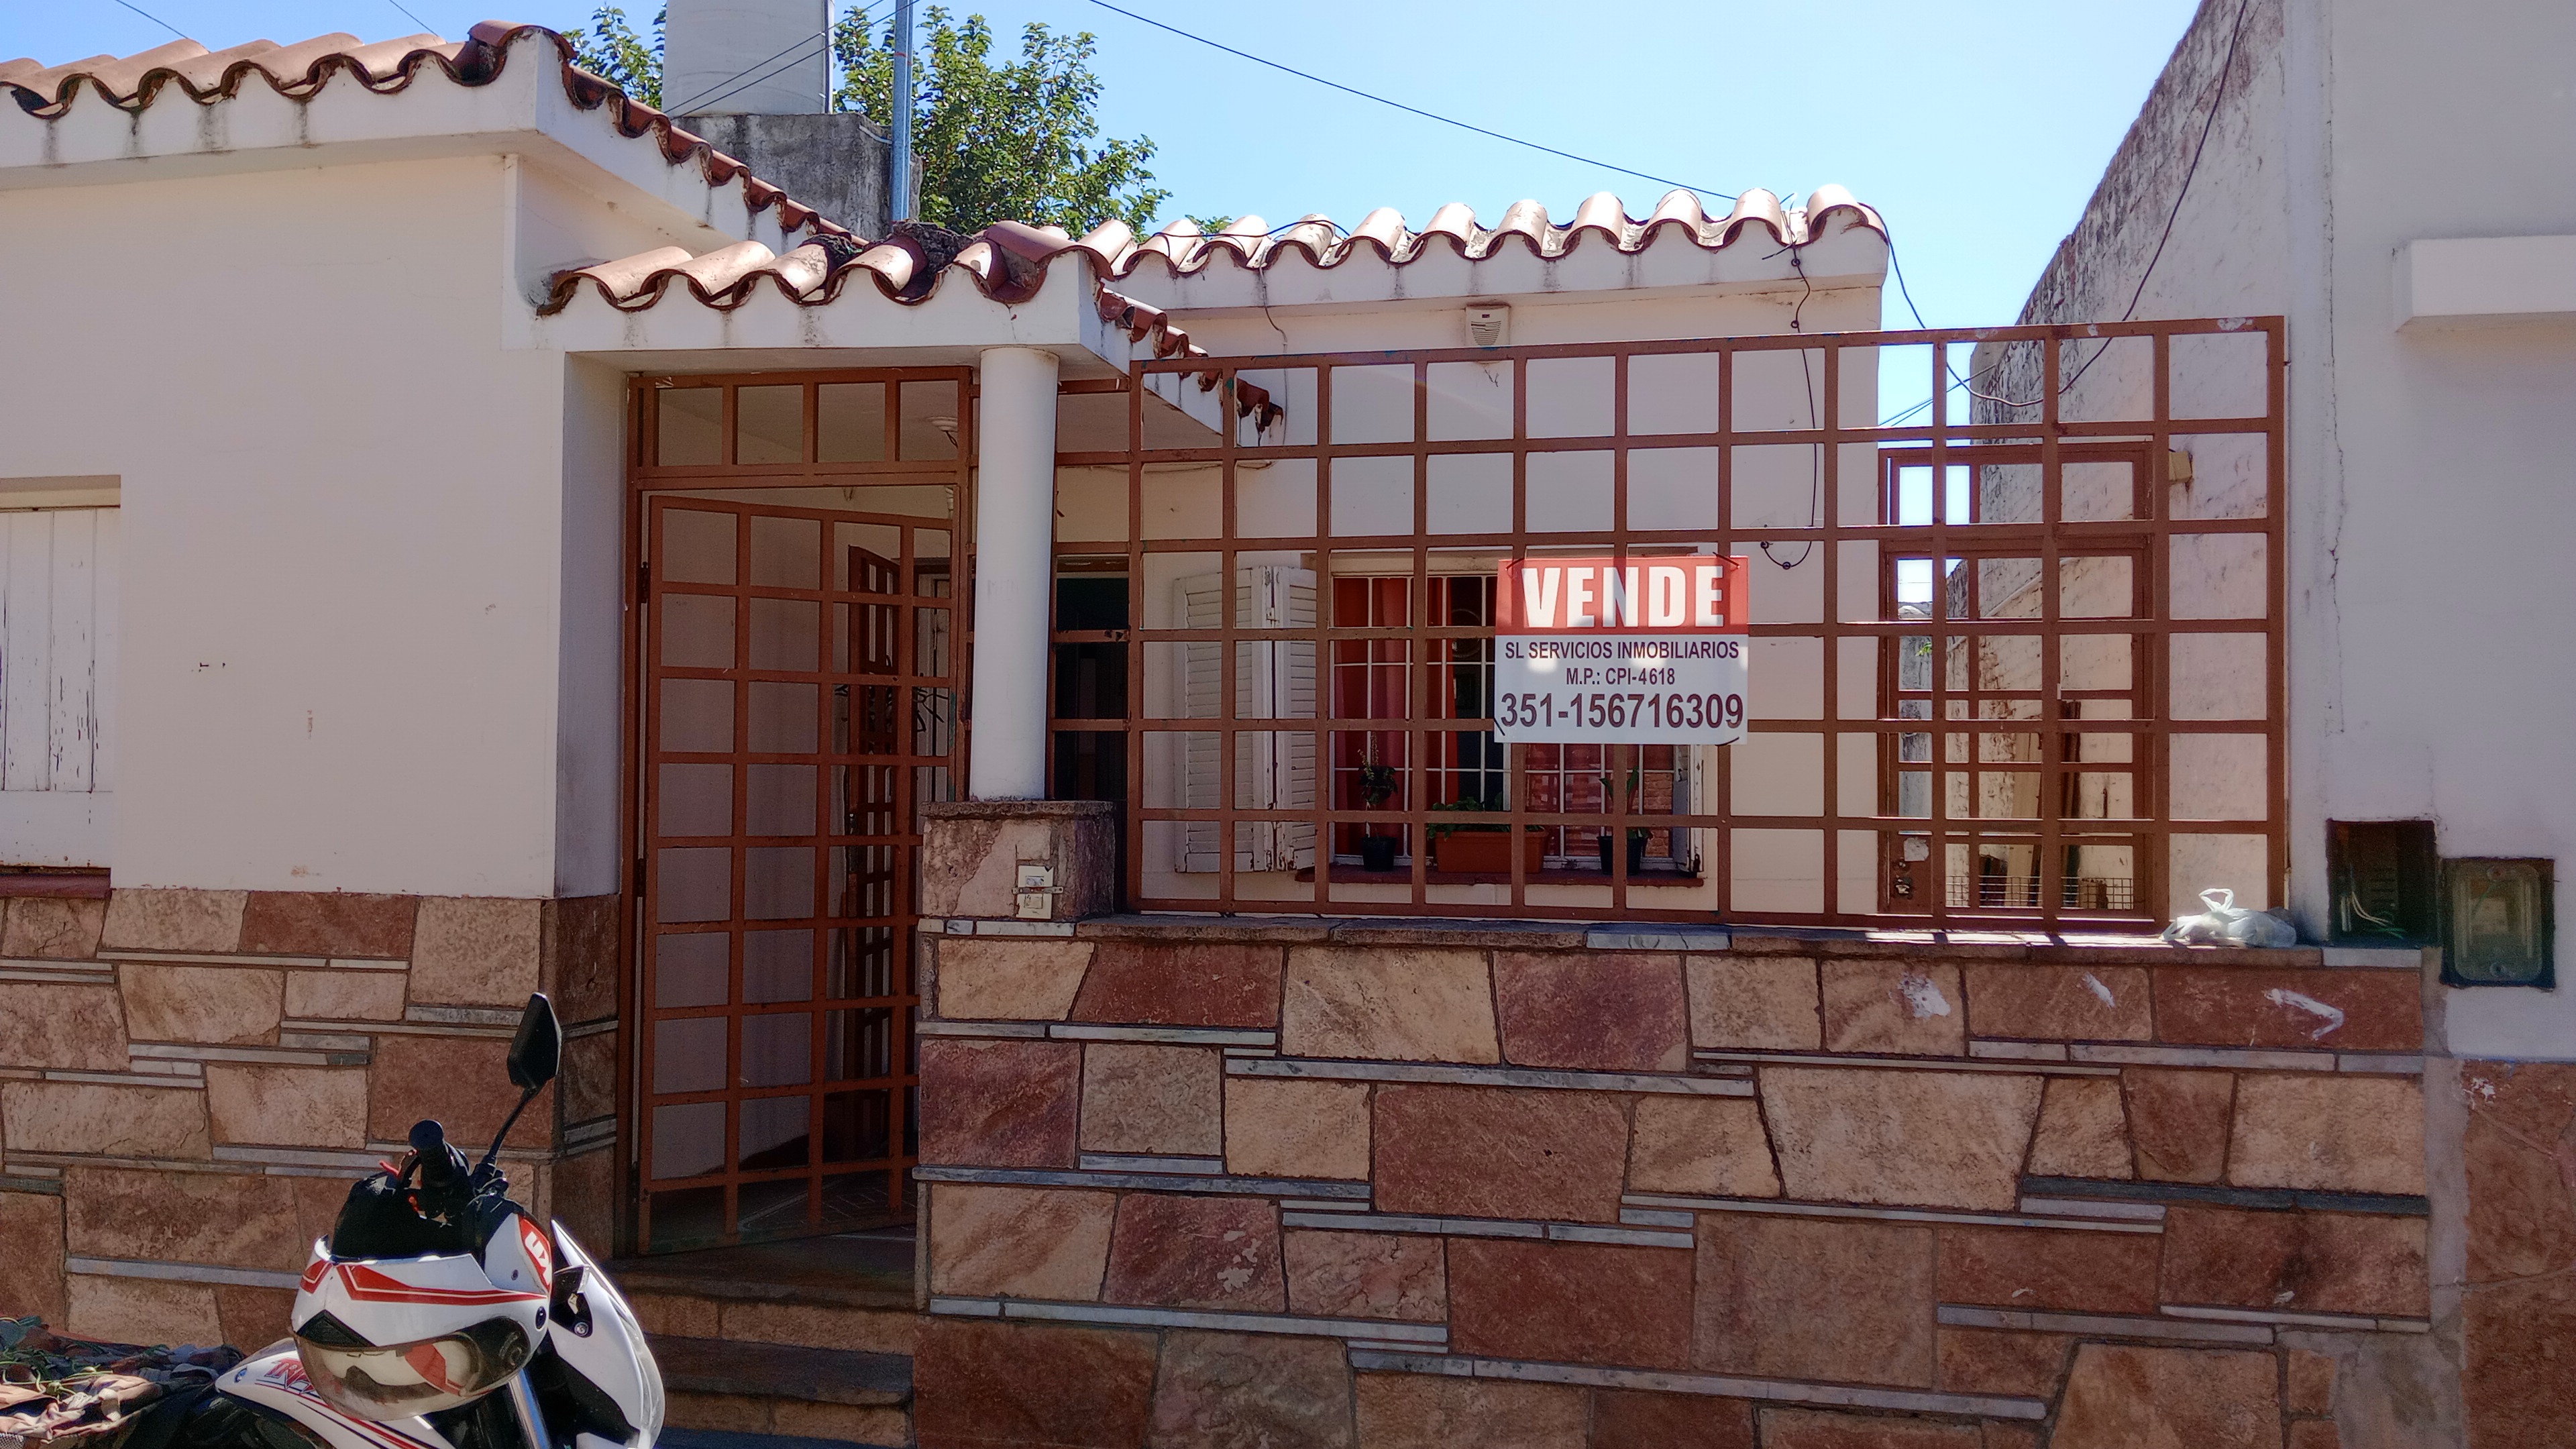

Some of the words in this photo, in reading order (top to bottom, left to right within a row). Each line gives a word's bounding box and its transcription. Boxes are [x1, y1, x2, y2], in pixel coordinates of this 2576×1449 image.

[1521, 566, 1723, 627] VENDE
[1505, 642, 1524, 659] SL
[1528, 642, 1612, 659] SERVICIOS
[1617, 641, 1739, 659] INMOBILIARIOS
[1566, 667, 1600, 685] M.P.:
[1605, 667, 1675, 685] CPI-4618
[1501, 692, 1743, 729] 351-156716309
